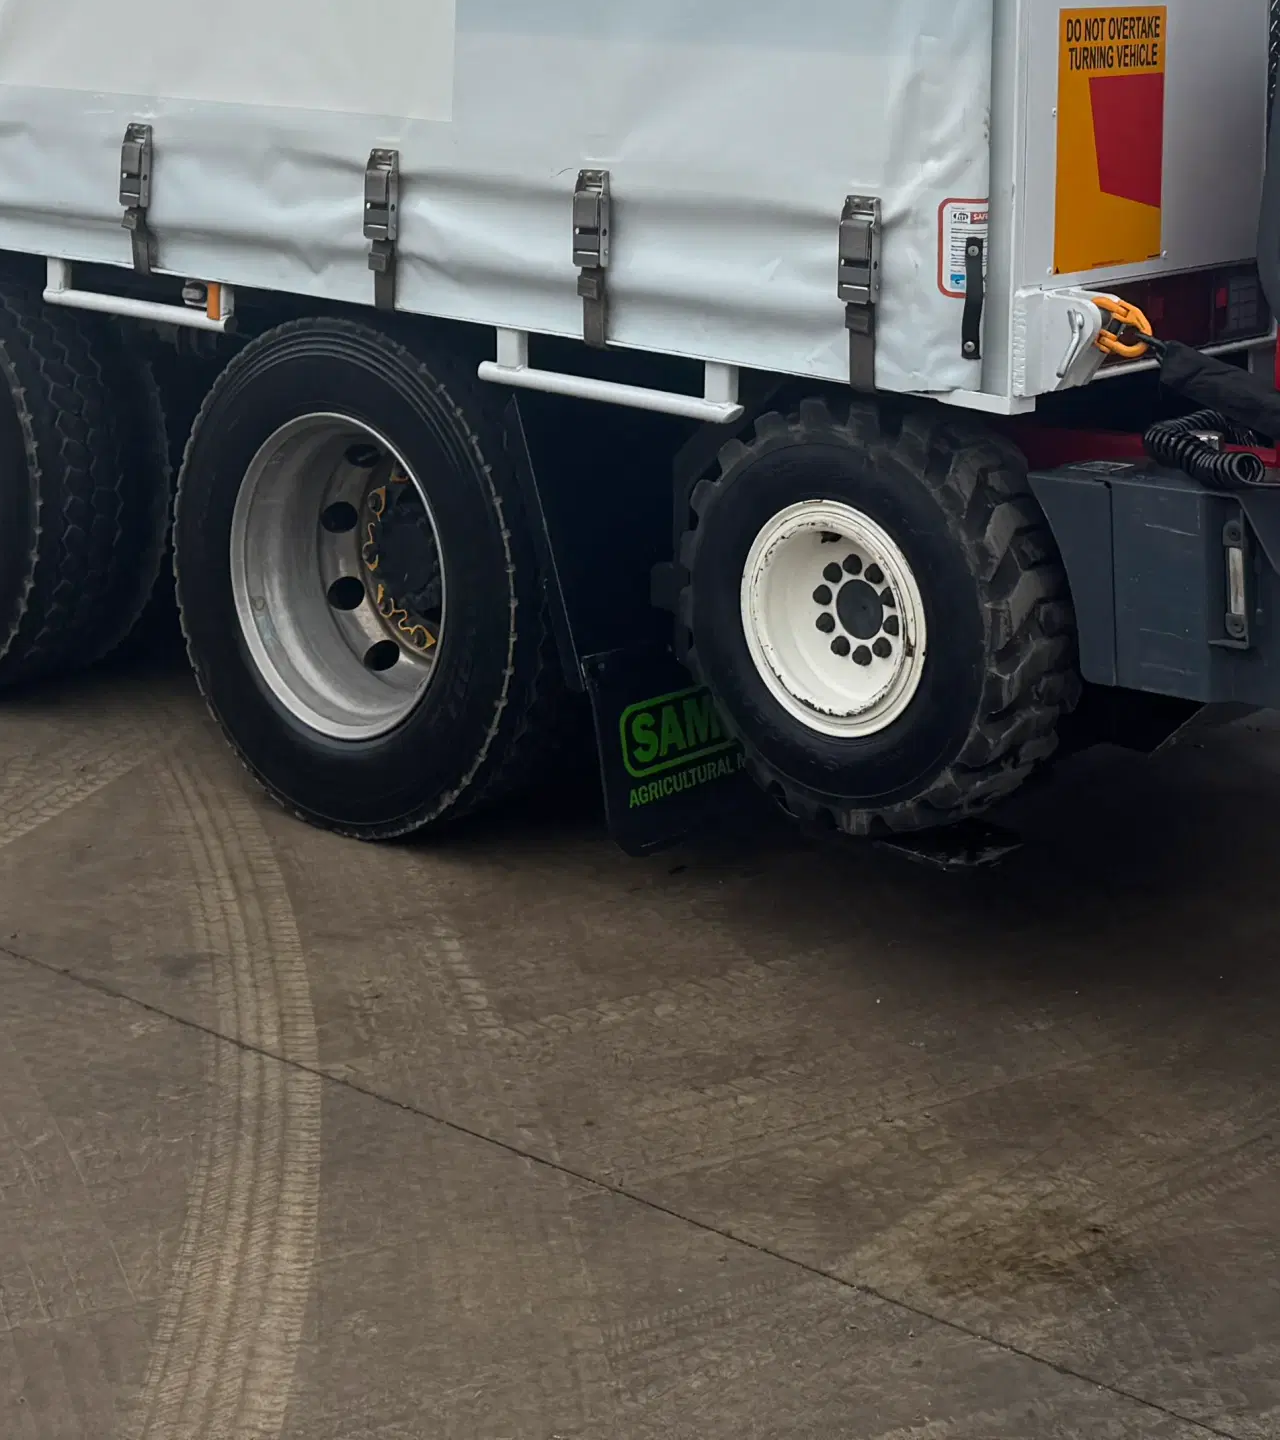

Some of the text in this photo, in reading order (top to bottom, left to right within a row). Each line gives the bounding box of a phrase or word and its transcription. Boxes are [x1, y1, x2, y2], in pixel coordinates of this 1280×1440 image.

[1066, 15, 1161, 42] DO NOT OVERTAKE
[1069, 43, 1158, 71] TURNING VEHICLE
[631, 694, 723, 762] SAM
[629, 755, 736, 809] AGRICULTURAL
